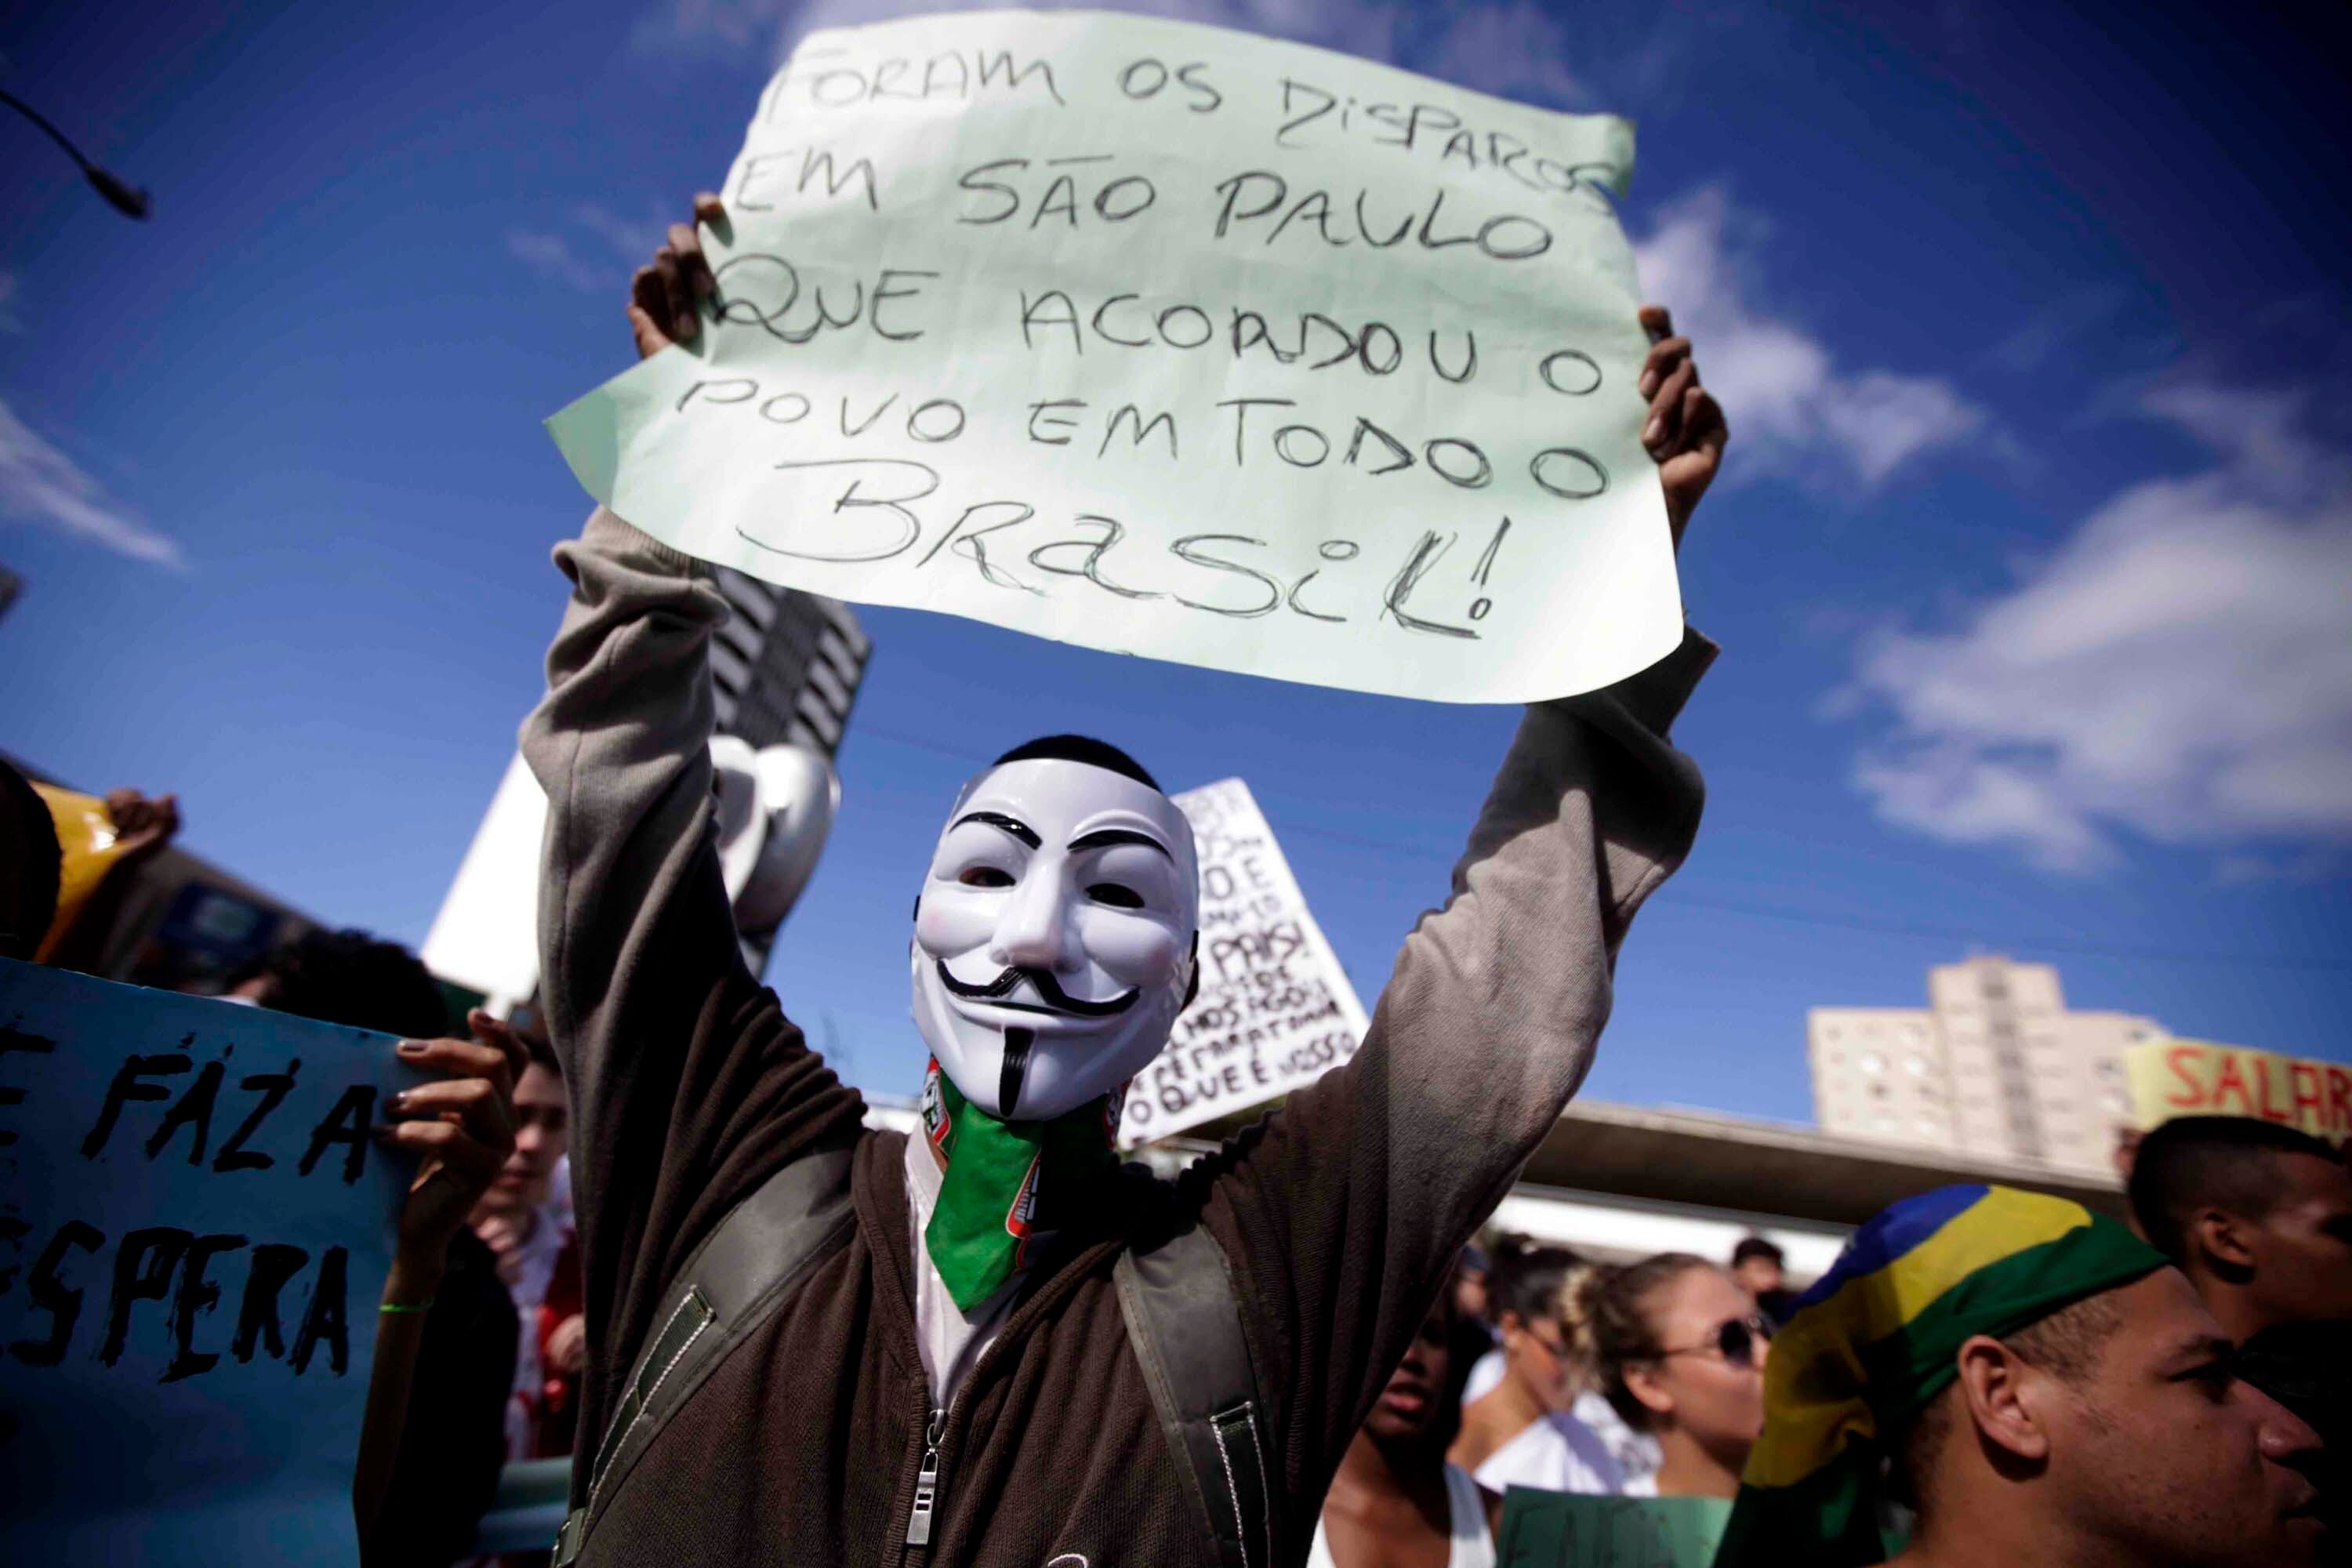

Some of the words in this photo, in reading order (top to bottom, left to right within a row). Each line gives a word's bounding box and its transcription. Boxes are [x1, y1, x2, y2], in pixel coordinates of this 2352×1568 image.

[767, 47, 1066, 124] FORAM
[1120, 58, 1223, 112] OS
[735, 147, 879, 212] EM
[956, 154, 1156, 230] SÃO
[1214, 171, 1552, 260] PAULO
[713, 253, 939, 343] QUE
[1019, 290, 1477, 383] ACORDOU
[1539, 350, 1602, 394] O
[677, 378, 966, 443] POVO
[1028, 398, 1177, 459] EM
[1215, 399, 1493, 489] TODO
[1530, 447, 1610, 500] O
